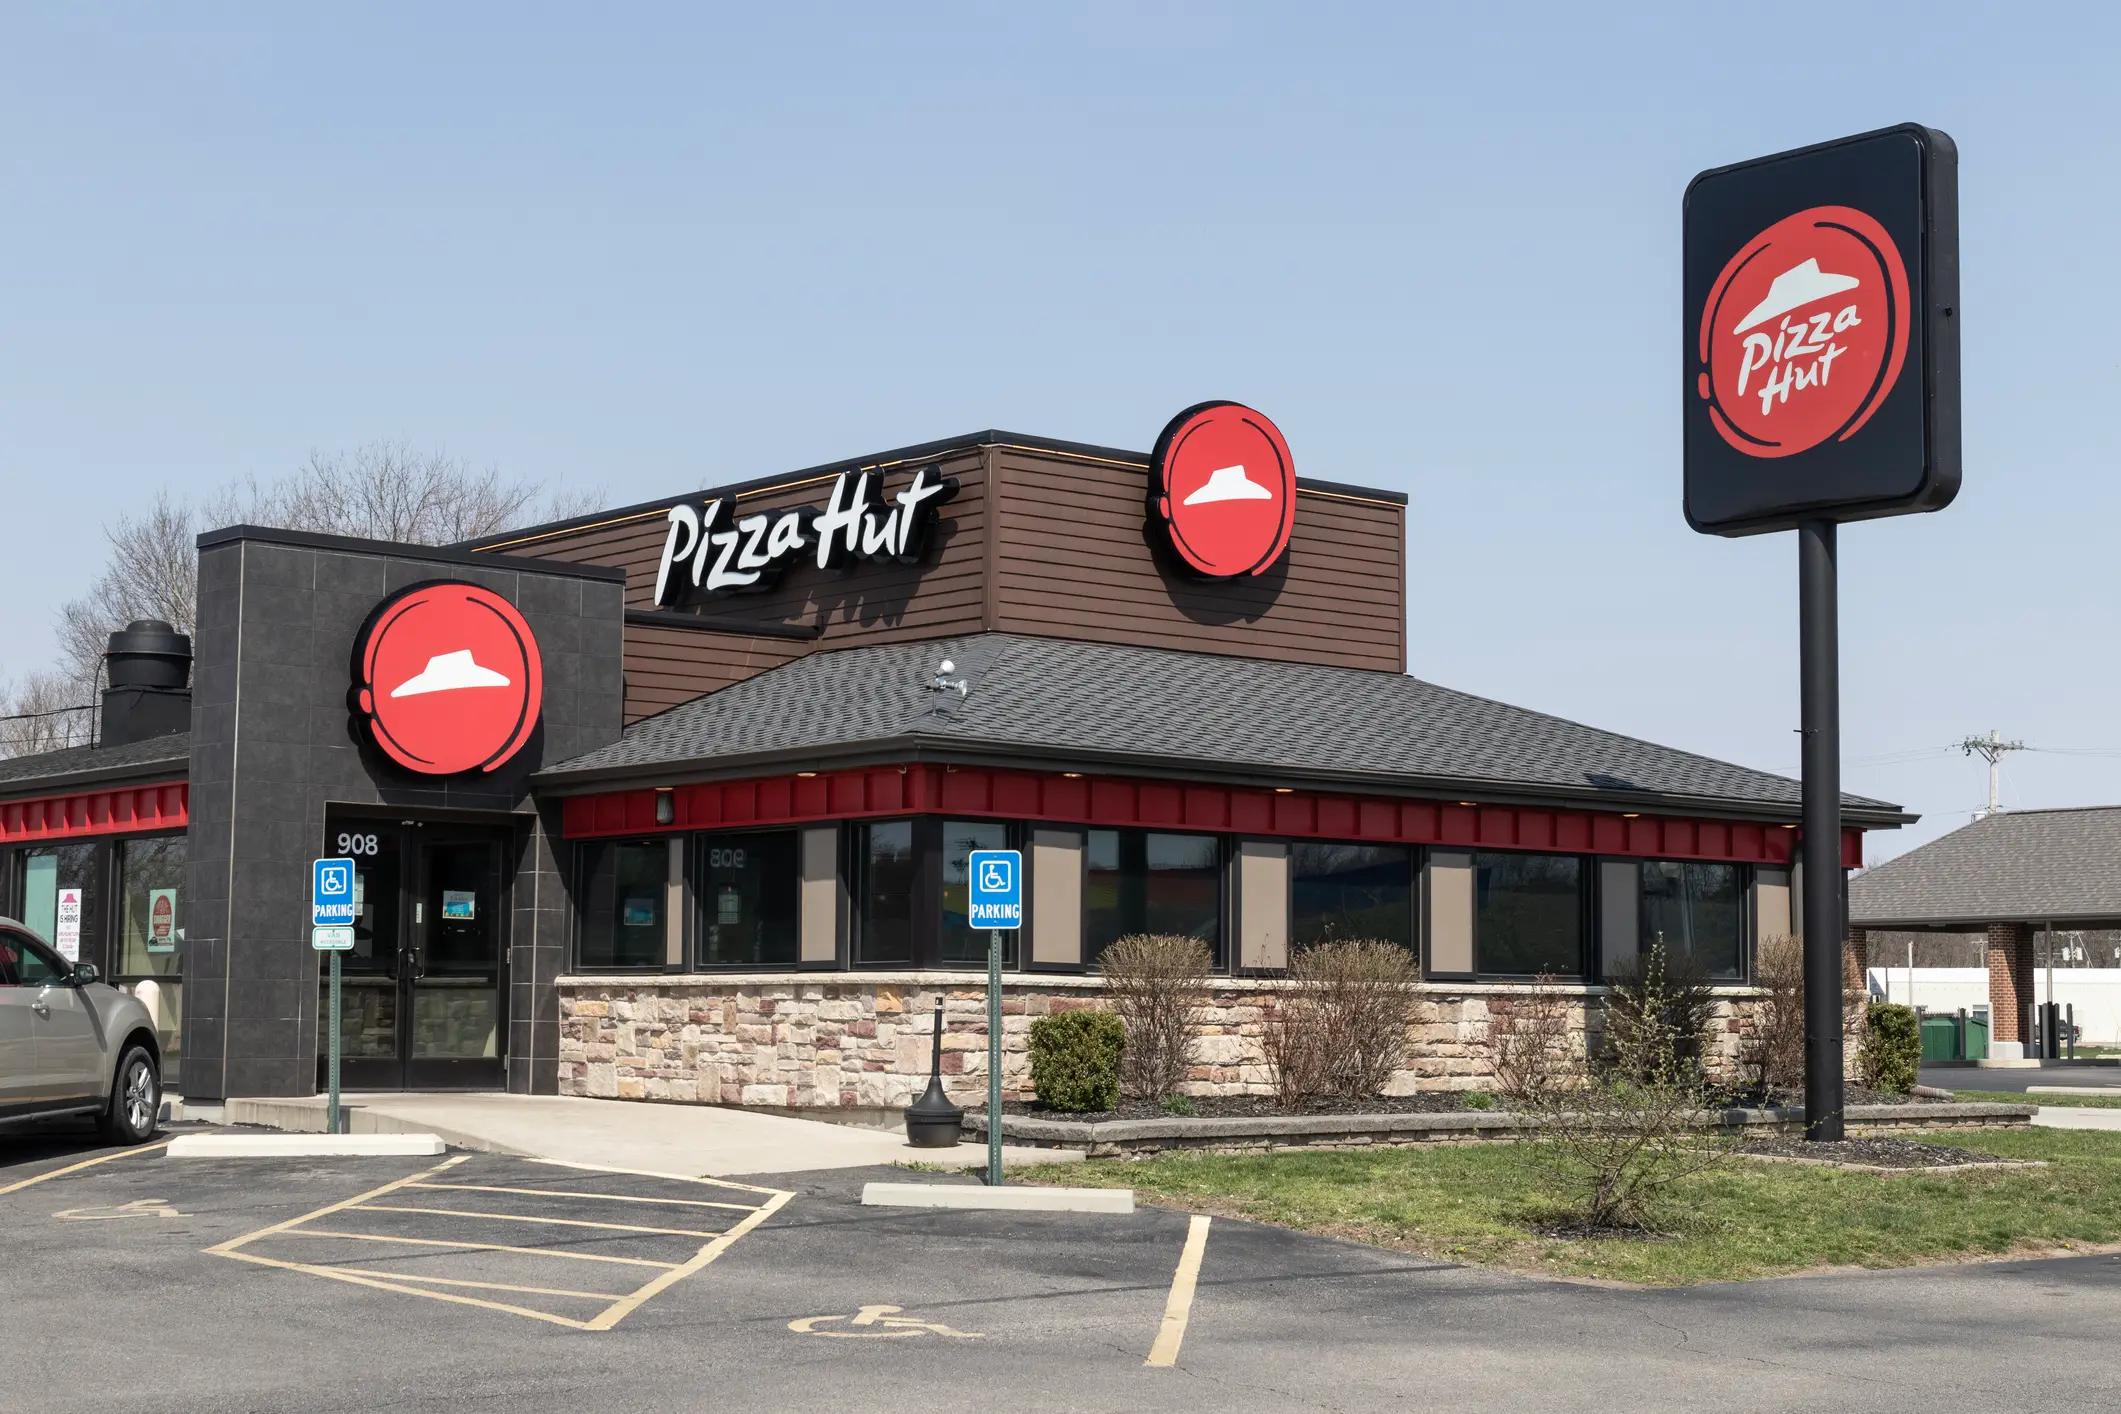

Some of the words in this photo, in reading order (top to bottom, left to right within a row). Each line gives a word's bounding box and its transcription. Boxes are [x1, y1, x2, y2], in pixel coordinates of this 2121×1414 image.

[1738, 304, 1862, 397] Pizza
[1757, 343, 1848, 416] Hut
[654, 498, 806, 606] Pizza
[812, 470, 943, 569] Hut
[337, 832, 379, 856] 908
[64, 914, 79, 923] HIRING
[314, 903, 354, 918] PARKING
[971, 903, 1021, 919] PARKING
